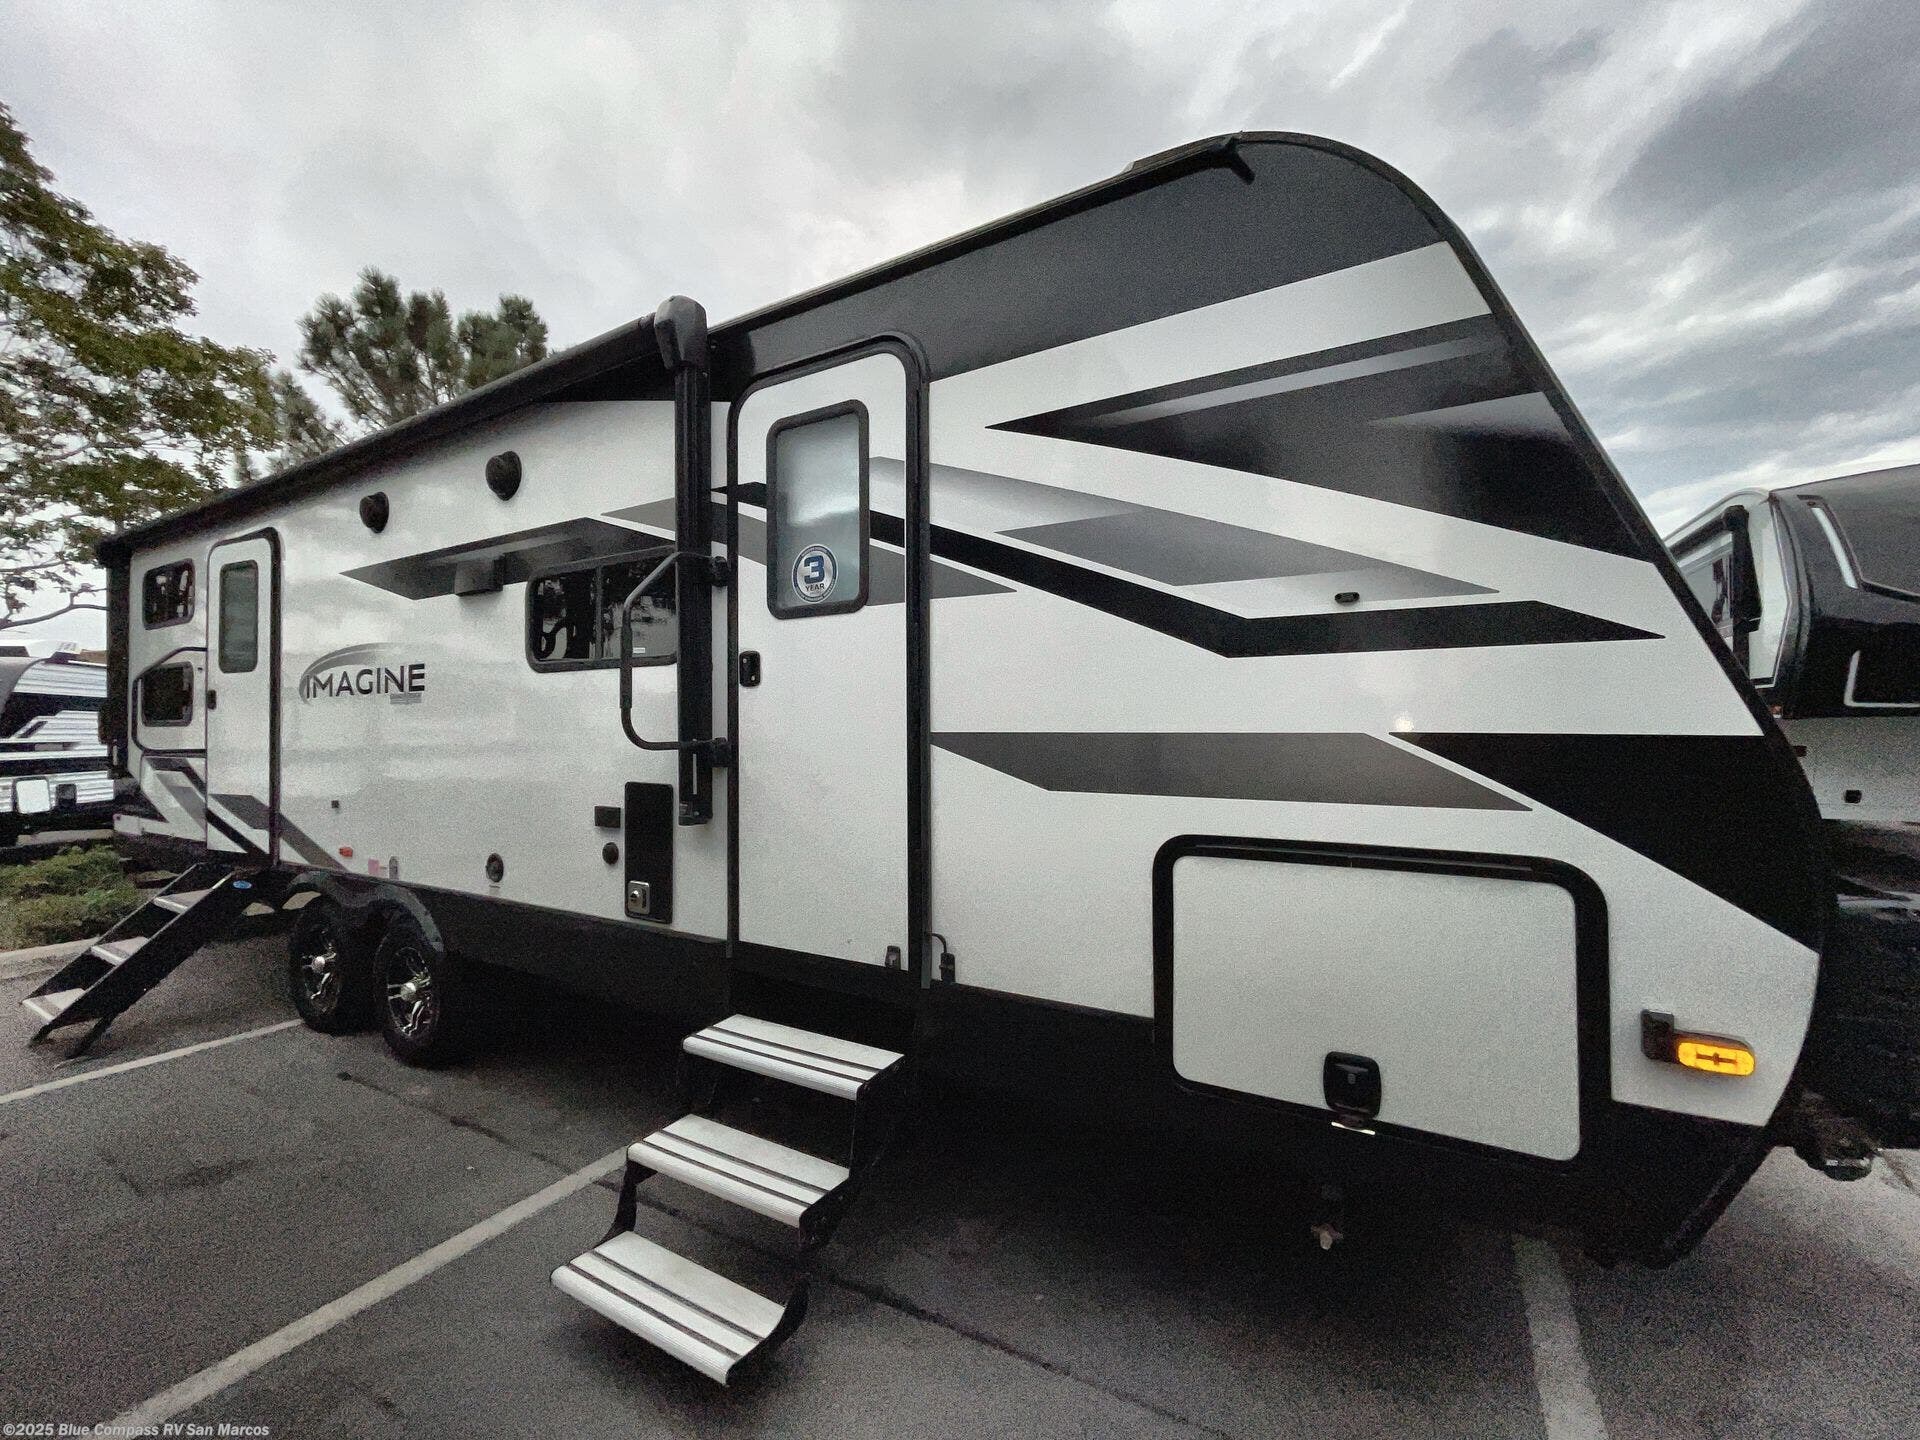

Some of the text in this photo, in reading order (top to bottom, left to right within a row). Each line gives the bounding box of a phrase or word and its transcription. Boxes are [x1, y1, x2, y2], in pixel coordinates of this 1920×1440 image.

[804, 555, 825, 584] 3
[805, 582, 825, 592] YEAR
[306, 663, 425, 699] IMAGINE
